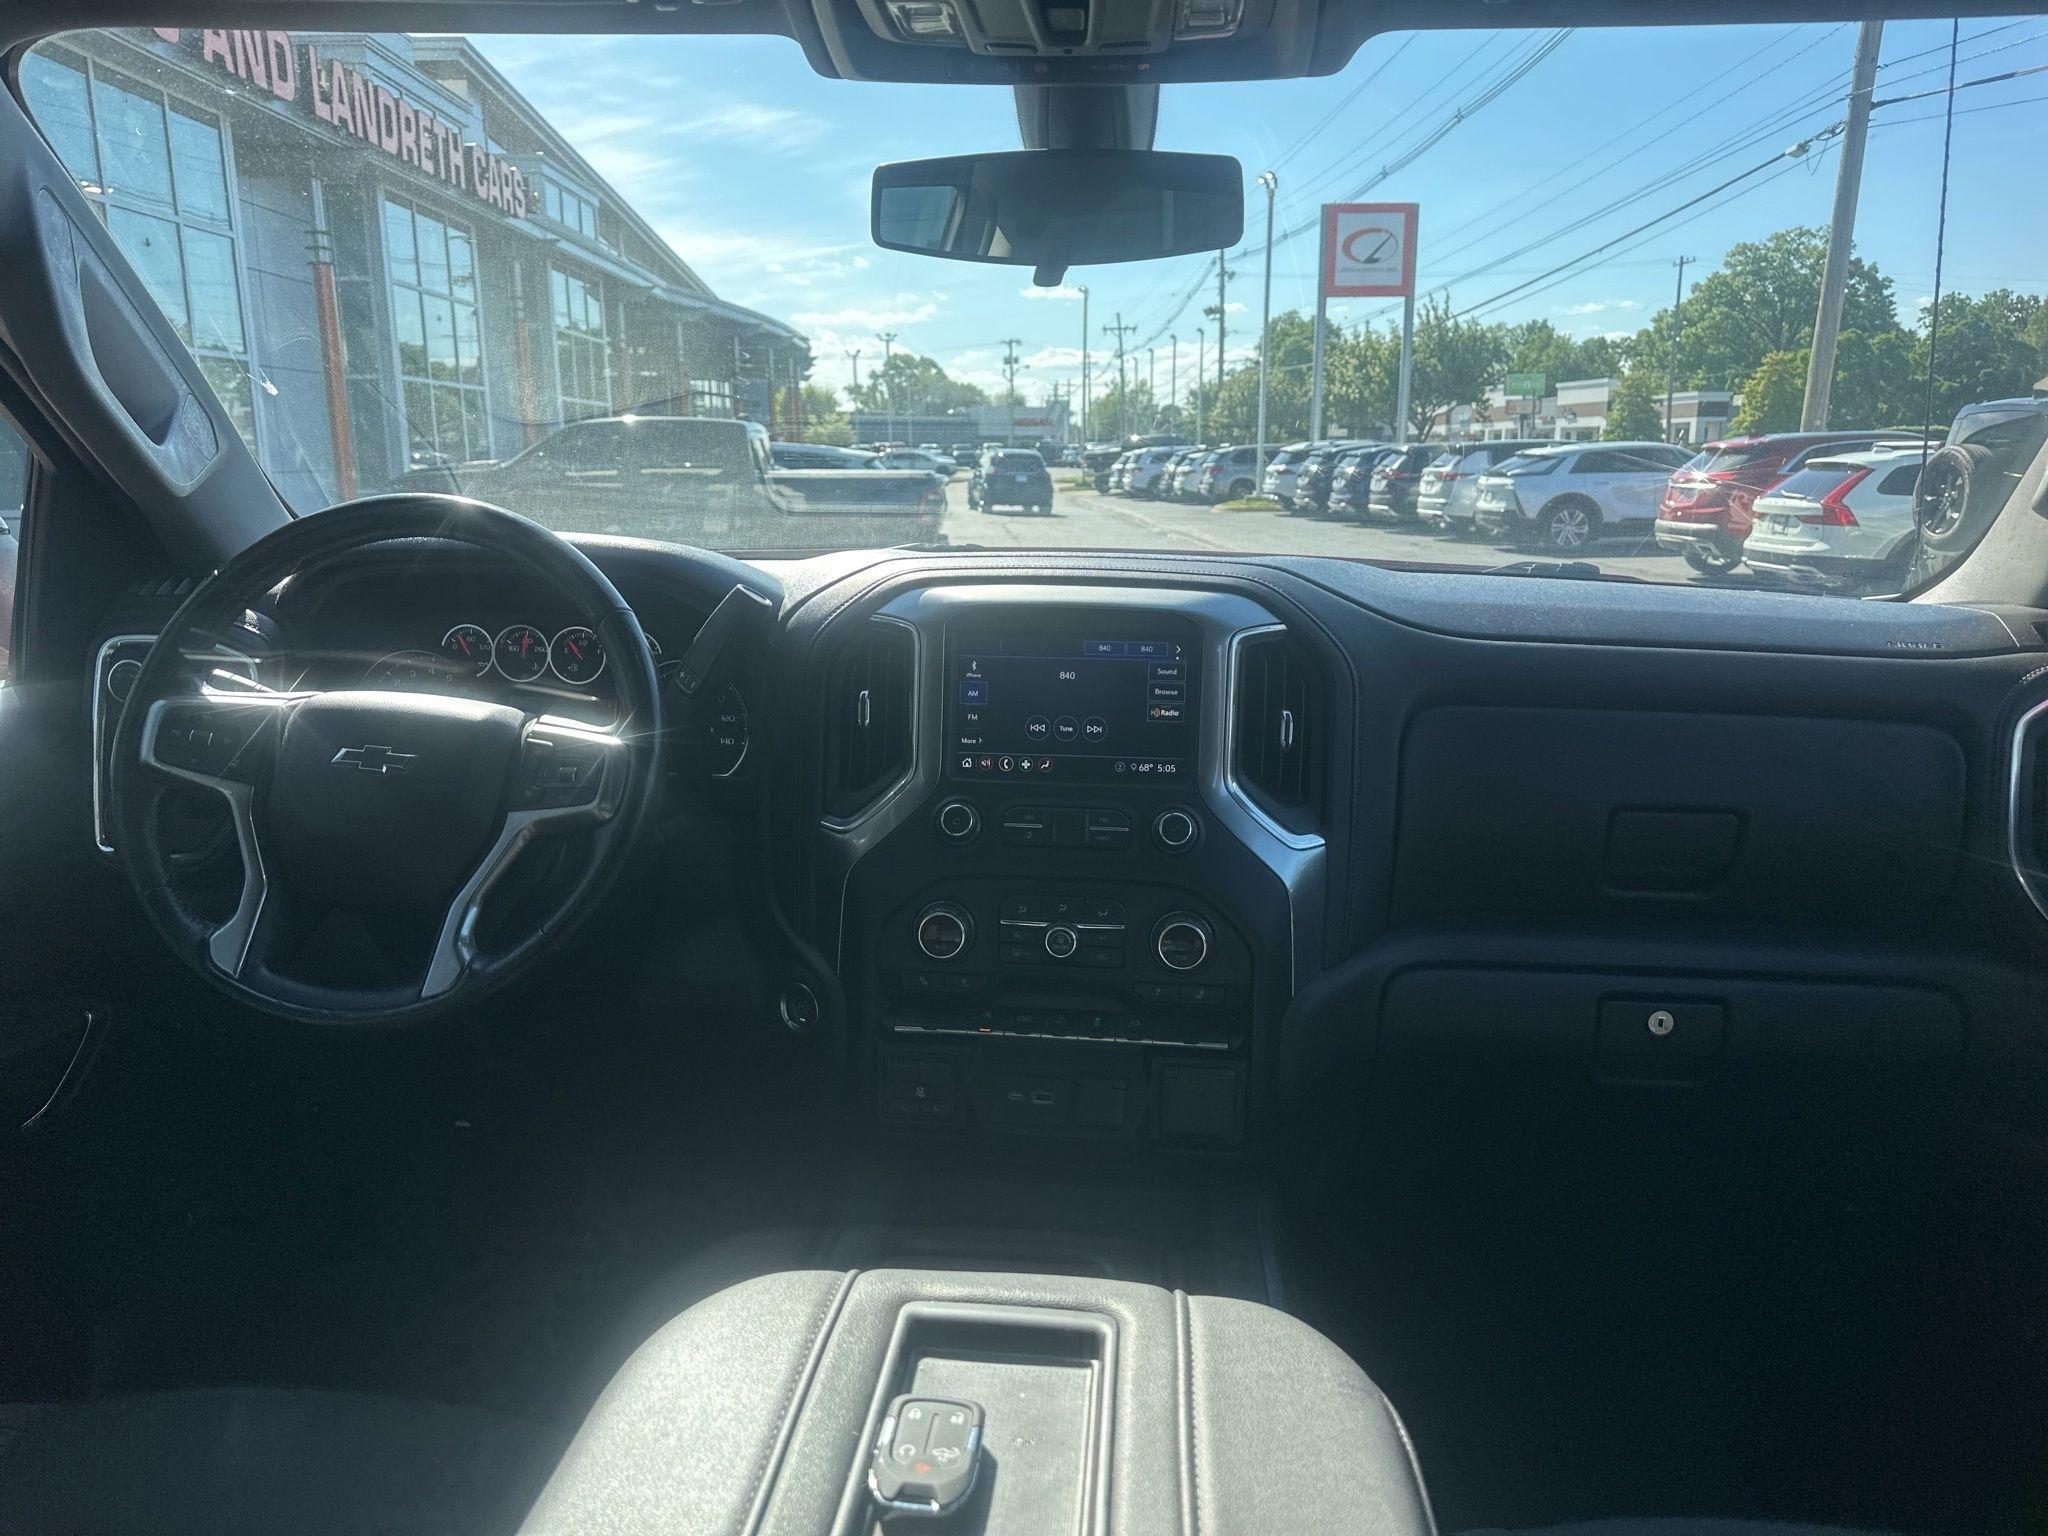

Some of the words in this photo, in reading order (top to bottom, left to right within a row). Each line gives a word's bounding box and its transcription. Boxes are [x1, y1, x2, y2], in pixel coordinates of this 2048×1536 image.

[203, 28, 295, 101] AND
[308, 44, 466, 190] LANDRETH
[472, 142, 527, 219] CARS
[1157, 667, 1178, 675] Sound
[1059, 671, 1076, 680] 840
[1154, 688, 1179, 696] Browse
[967, 713, 978, 721] FM
[1161, 709, 1179, 717] Radio
[1157, 763, 1176, 773] 5:05
